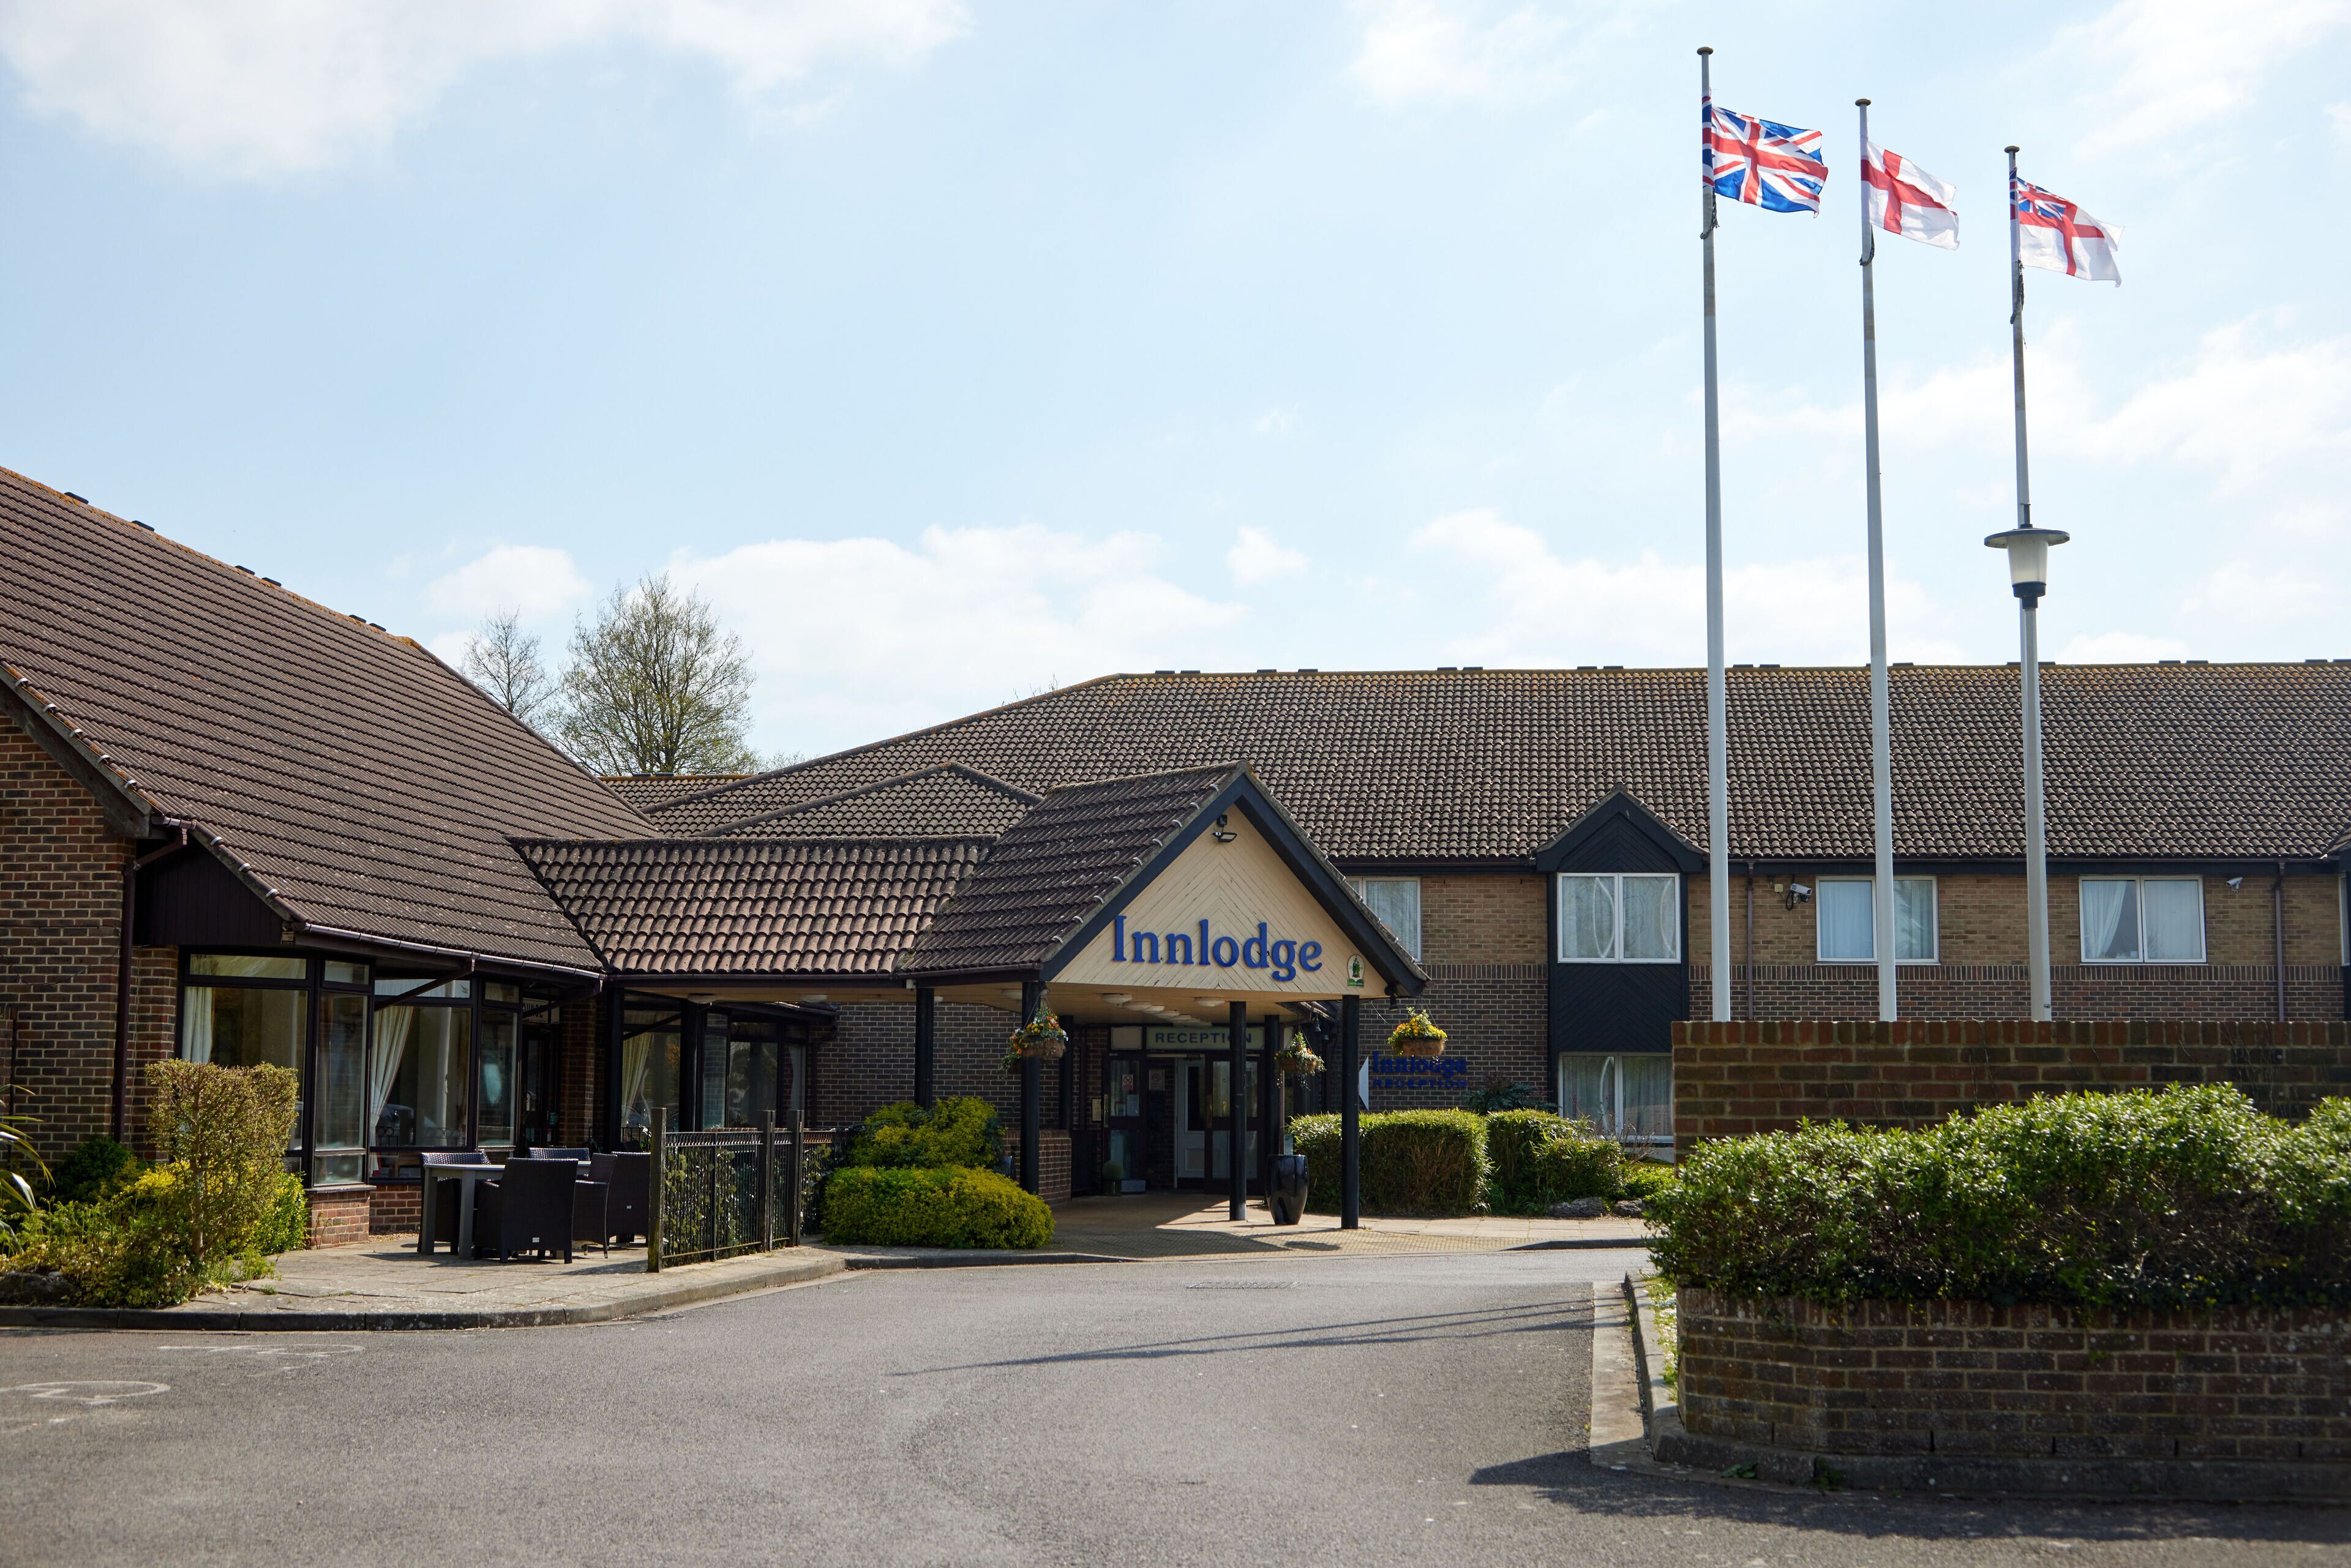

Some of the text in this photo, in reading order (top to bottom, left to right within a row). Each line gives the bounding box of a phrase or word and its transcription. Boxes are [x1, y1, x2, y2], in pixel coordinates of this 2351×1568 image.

[1113, 915, 1322, 981] Innlodge
[1155, 1032, 1251, 1043] RECEPTIN
[1372, 1051, 1468, 1078] Innlodge
[1372, 1079, 1467, 1088] RECEPTION
